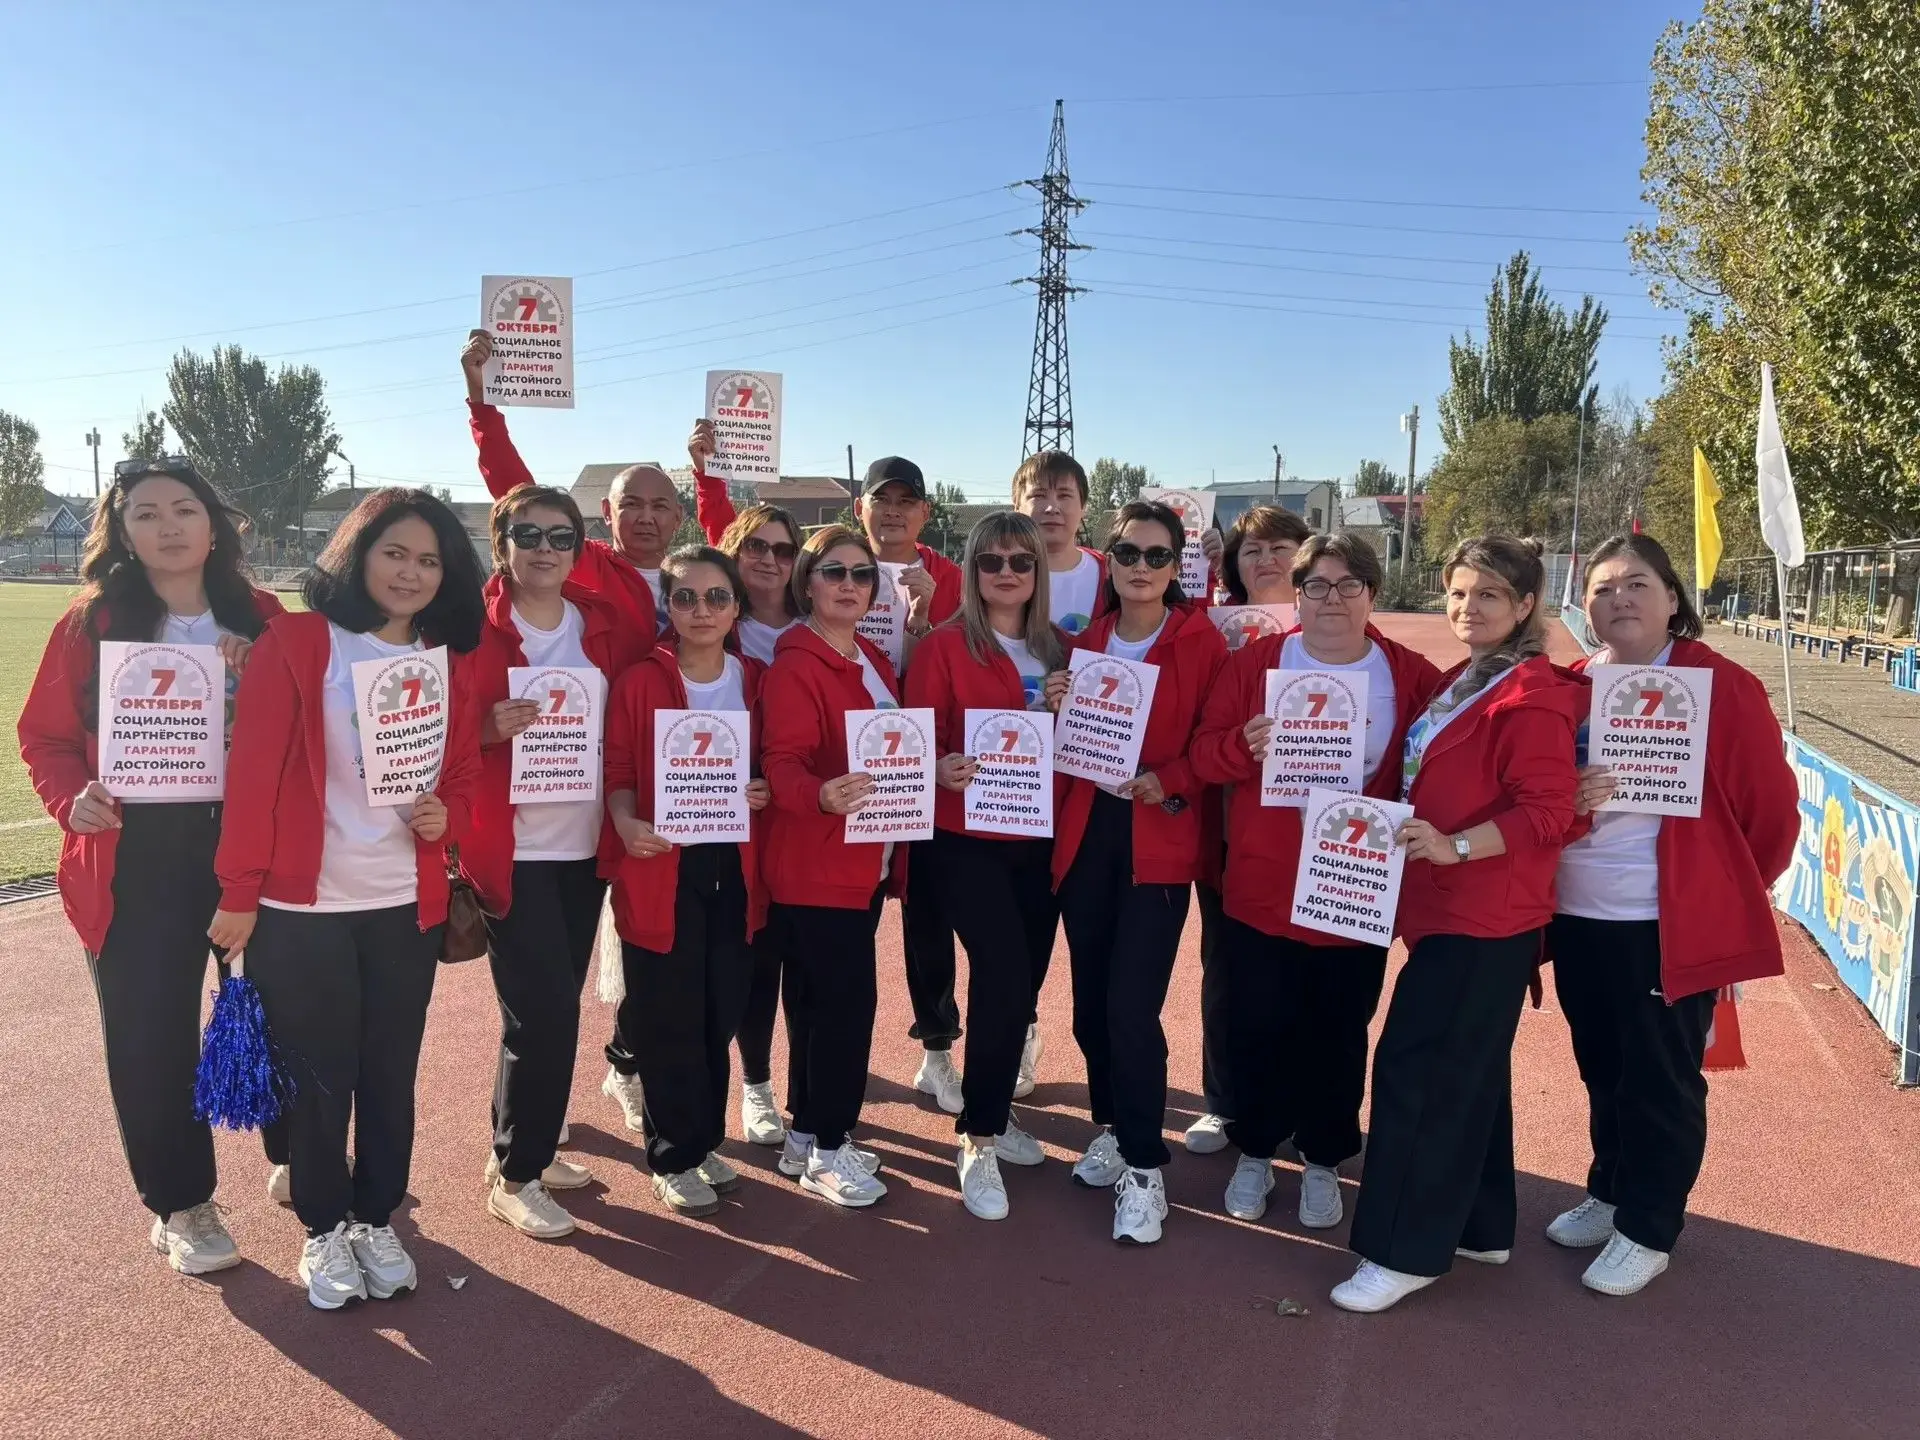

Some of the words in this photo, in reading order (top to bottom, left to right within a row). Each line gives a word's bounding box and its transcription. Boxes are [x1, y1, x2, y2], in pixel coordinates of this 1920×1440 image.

[519, 298, 537, 321] 7
[496, 322, 557, 333] ОКТЯБРЯ
[492, 337, 561, 347] СОЦИАЛЬНОЕ
[492, 350, 562, 359] ПАРТНЁРСТВО
[502, 363, 553, 372] ГАРАНТИЯ
[494, 375, 562, 385] ДОСТОЙНОГО
[486, 387, 518, 397] ТРУДА
[521, 390, 542, 398] ДЛЯ
[545, 390, 571, 398] ВСЕХ!
[737, 388, 752, 407] 7
[718, 408, 768, 419] ОКТЯБРЯ
[714, 420, 771, 430] СОЦИАЛЬНОЕ
[713, 431, 772, 441] ПАРТНЁРСТВО
[720, 442, 764, 451] ГАРАНТИЯ
[714, 452, 770, 462] ДОСТОЙНОГО
[707, 461, 732, 470] ТРУДА
[755, 465, 778, 473] ВСЕХ!
[151, 669, 175, 696] 7
[1099, 676, 1119, 699] 7
[402, 679, 421, 707] 7
[120, 699, 202, 710] ОКТЯБРЯ
[549, 690, 566, 714] 7
[1075, 696, 1133, 716] ОКТЯБРЯ
[1308, 693, 1327, 718] 7
[1640, 691, 1663, 716] 7
[378, 702, 441, 725] ОКТЯБРЯ
[1069, 709, 1134, 730] СОЦИАЛЬНОЕ
[114, 716, 208, 726] СОЦИАЛЬНОЕ
[1282, 720, 1348, 730] ОКТЯБРЯ
[1610, 718, 1687, 731] ОКТЯБРЯ
[113, 729, 208, 740] ПАРТНЁРСТВО
[376, 717, 444, 740] СОЦИАЛЬНОЕ
[1066, 720, 1131, 741] ПАРТНЁРСТВО
[523, 731, 587, 739] СОЦИАЛЬНОЕ
[1001, 730, 1018, 752] 7
[1277, 736, 1352, 745] СОЦИАЛЬНОЕ
[1604, 734, 1691, 747] СОЦИАЛЬНОЕ
[522, 743, 587, 752] ПАРТНЁРСТВО
[693, 732, 712, 755] 7
[884, 732, 902, 755] 7
[1071, 734, 1120, 751] ГАРАНТИЯ
[125, 746, 196, 755] ГАРАНТИЯ
[1061, 744, 1124, 765] ДОСТОЙНОГО
[1275, 748, 1352, 758] ПАРТНЁРСТВО
[1601, 748, 1690, 761] ПАРТНЁРСТВО
[389, 747, 440, 767] ГАРАНТИЯ
[670, 758, 733, 767] ОКТЯБРЯ
[864, 757, 921, 768] ОКТЯБРЯ
[979, 753, 1037, 765] ОКТЯБРЯ
[113, 759, 205, 771] ДОСТОЙНОГО
[1082, 762, 1102, 772] ДЛЯ
[1105, 766, 1131, 779] ВСЕХ!
[1284, 762, 1341, 770] ГАРАНТИЯ
[1612, 763, 1678, 774] ГАРАНТИЯ
[521, 768, 584, 780] ДОСТОЙНОГО
[666, 773, 736, 781] СОЦИАЛЬНОЕ
[1274, 773, 1349, 784] ДОСТОЙНОГО
[102, 776, 145, 786] ТРУДА
[149, 776, 177, 786] ДЛЯ
[181, 776, 217, 784] ВСЕХ!
[974, 778, 1041, 790] ПАРТНЁРСТВО
[371, 784, 412, 795] ТРУДА
[512, 784, 542, 793] ТРУДА
[544, 784, 564, 792] ДЛЯ
[567, 782, 592, 791] ВСЕХ!
[665, 783, 737, 794] ПАРТНЁРСТВО
[1264, 788, 1299, 797] ТРУДА
[674, 798, 728, 806] ГАРАНТИЯ
[983, 791, 1032, 801] ГАРАНТИЯ
[1611, 792, 1628, 800] ДА
[1632, 792, 1659, 802] ДЛЯ
[1663, 795, 1697, 804] ВСЕХ!
[975, 802, 1040, 814] ДОСТОЙНОГО
[666, 809, 736, 821] ДОСТОЙНОГО
[857, 810, 922, 821] ДОСТОЙНОГО
[967, 812, 998, 823] ТРУДА
[1000, 816, 1020, 825] ДЛЯ
[1023, 818, 1048, 827] ВСЕХ!
[657, 824, 690, 833] ТРУДА
[693, 824, 715, 833] ДЛЯ
[848, 824, 879, 833] ТРУДА
[882, 823, 902, 832] ДЛЯ
[905, 822, 930, 830] ВСЕХ!
[1347, 819, 1368, 844] 7
[1318, 841, 1387, 863] ОКТЯБРЯ
[1312, 855, 1389, 878] СОЦИАЛЬНОЕ
[1309, 868, 1387, 892] ПАРТНЁРСТВО
[1316, 883, 1375, 903] ГАРАНТИЯ
[1306, 895, 1381, 919] ДОСТОЙНОГО
[1295, 905, 1330, 921] ТРУДА
[1332, 915, 1356, 927] ДЛЯ
[1359, 921, 1390, 935] ВСЕХ!
